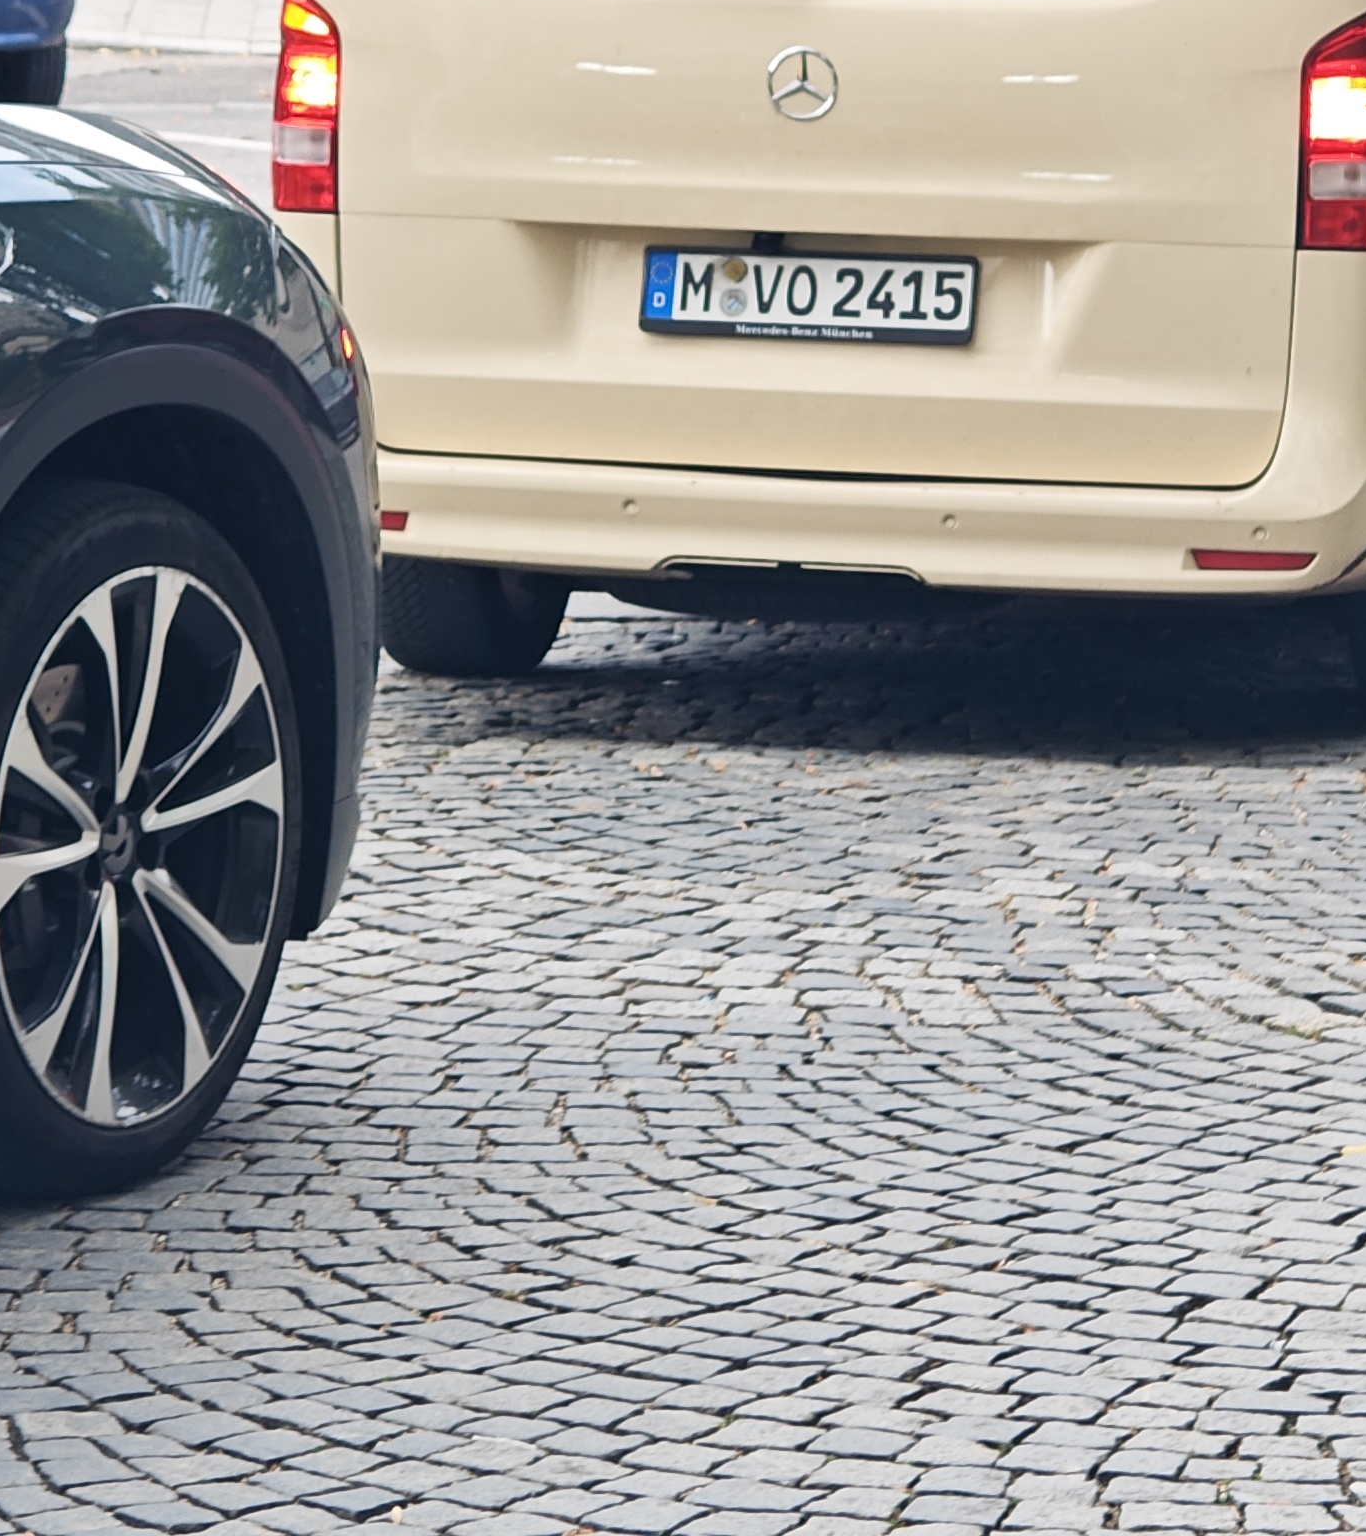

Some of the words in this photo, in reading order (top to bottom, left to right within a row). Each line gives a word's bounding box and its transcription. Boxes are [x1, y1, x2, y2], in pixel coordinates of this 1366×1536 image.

[652, 291, 667, 309] D
[679, 261, 715, 312] M
[753, 264, 818, 317] VO
[831, 267, 966, 321] 2415
